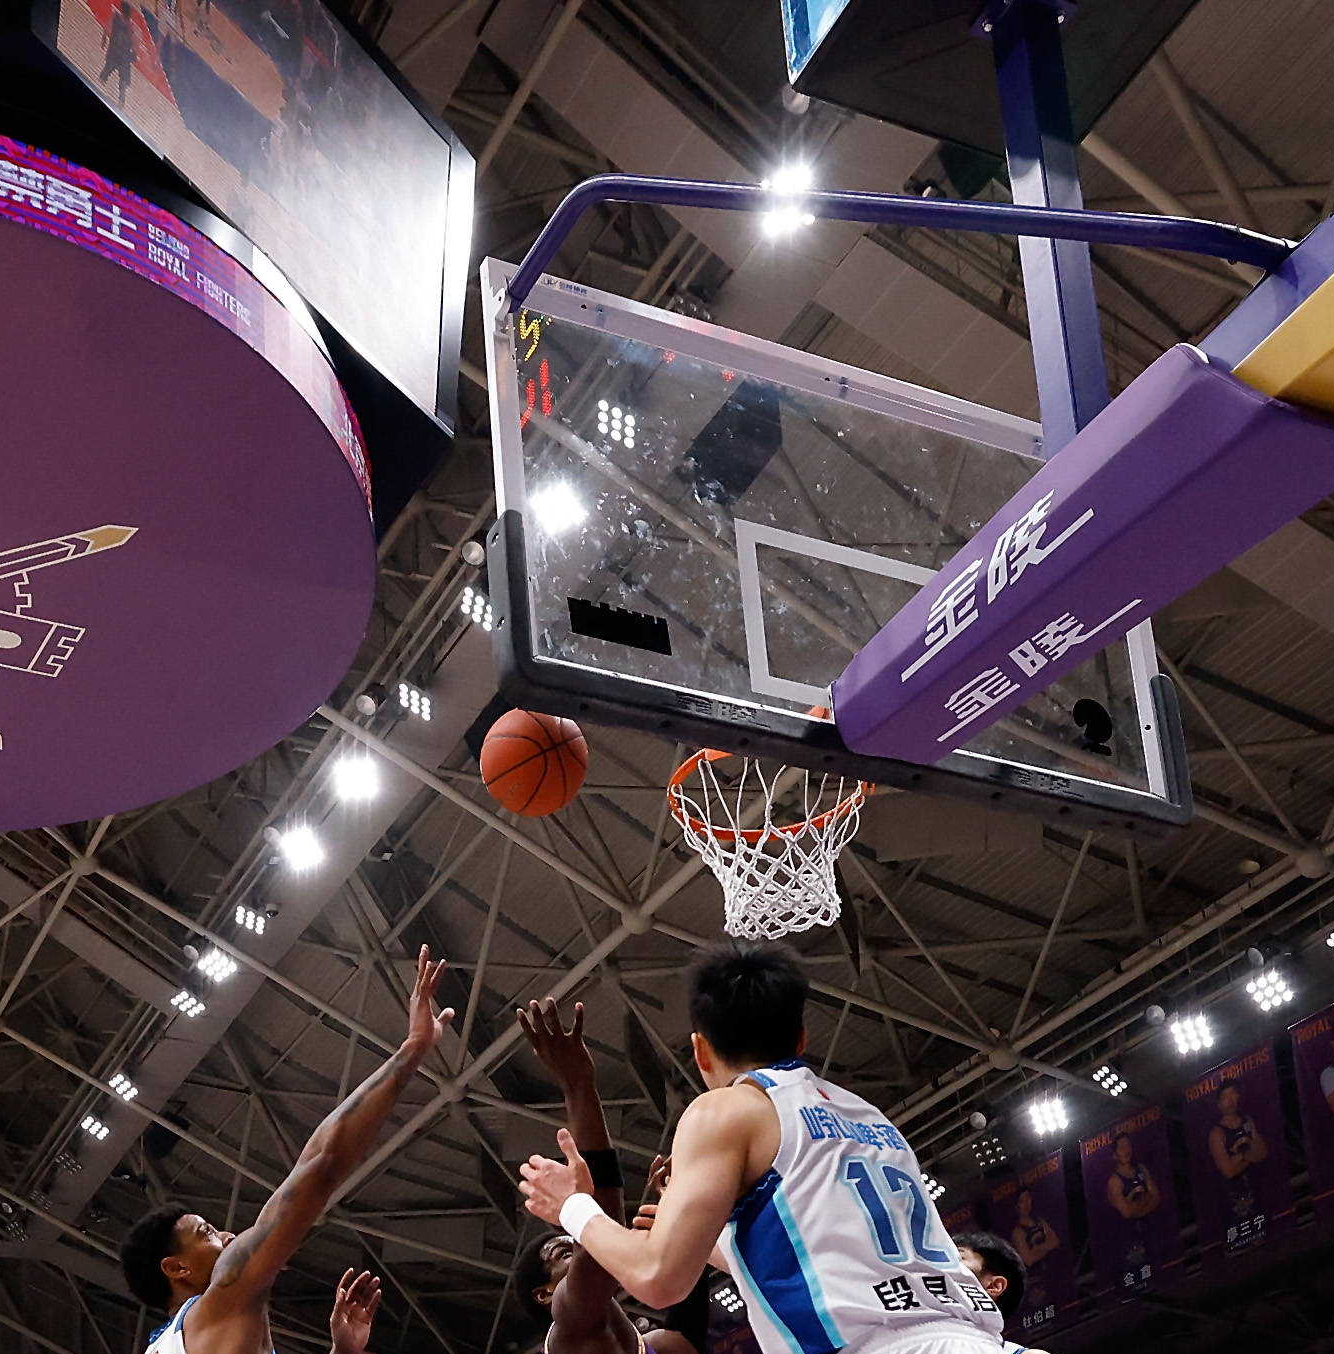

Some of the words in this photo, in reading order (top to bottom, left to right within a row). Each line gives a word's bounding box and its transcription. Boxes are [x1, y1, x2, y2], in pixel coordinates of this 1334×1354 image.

[901, 489, 1095, 683] 金陵
[936, 598, 1143, 743] 金陵
[845, 1160, 951, 1263] 12
